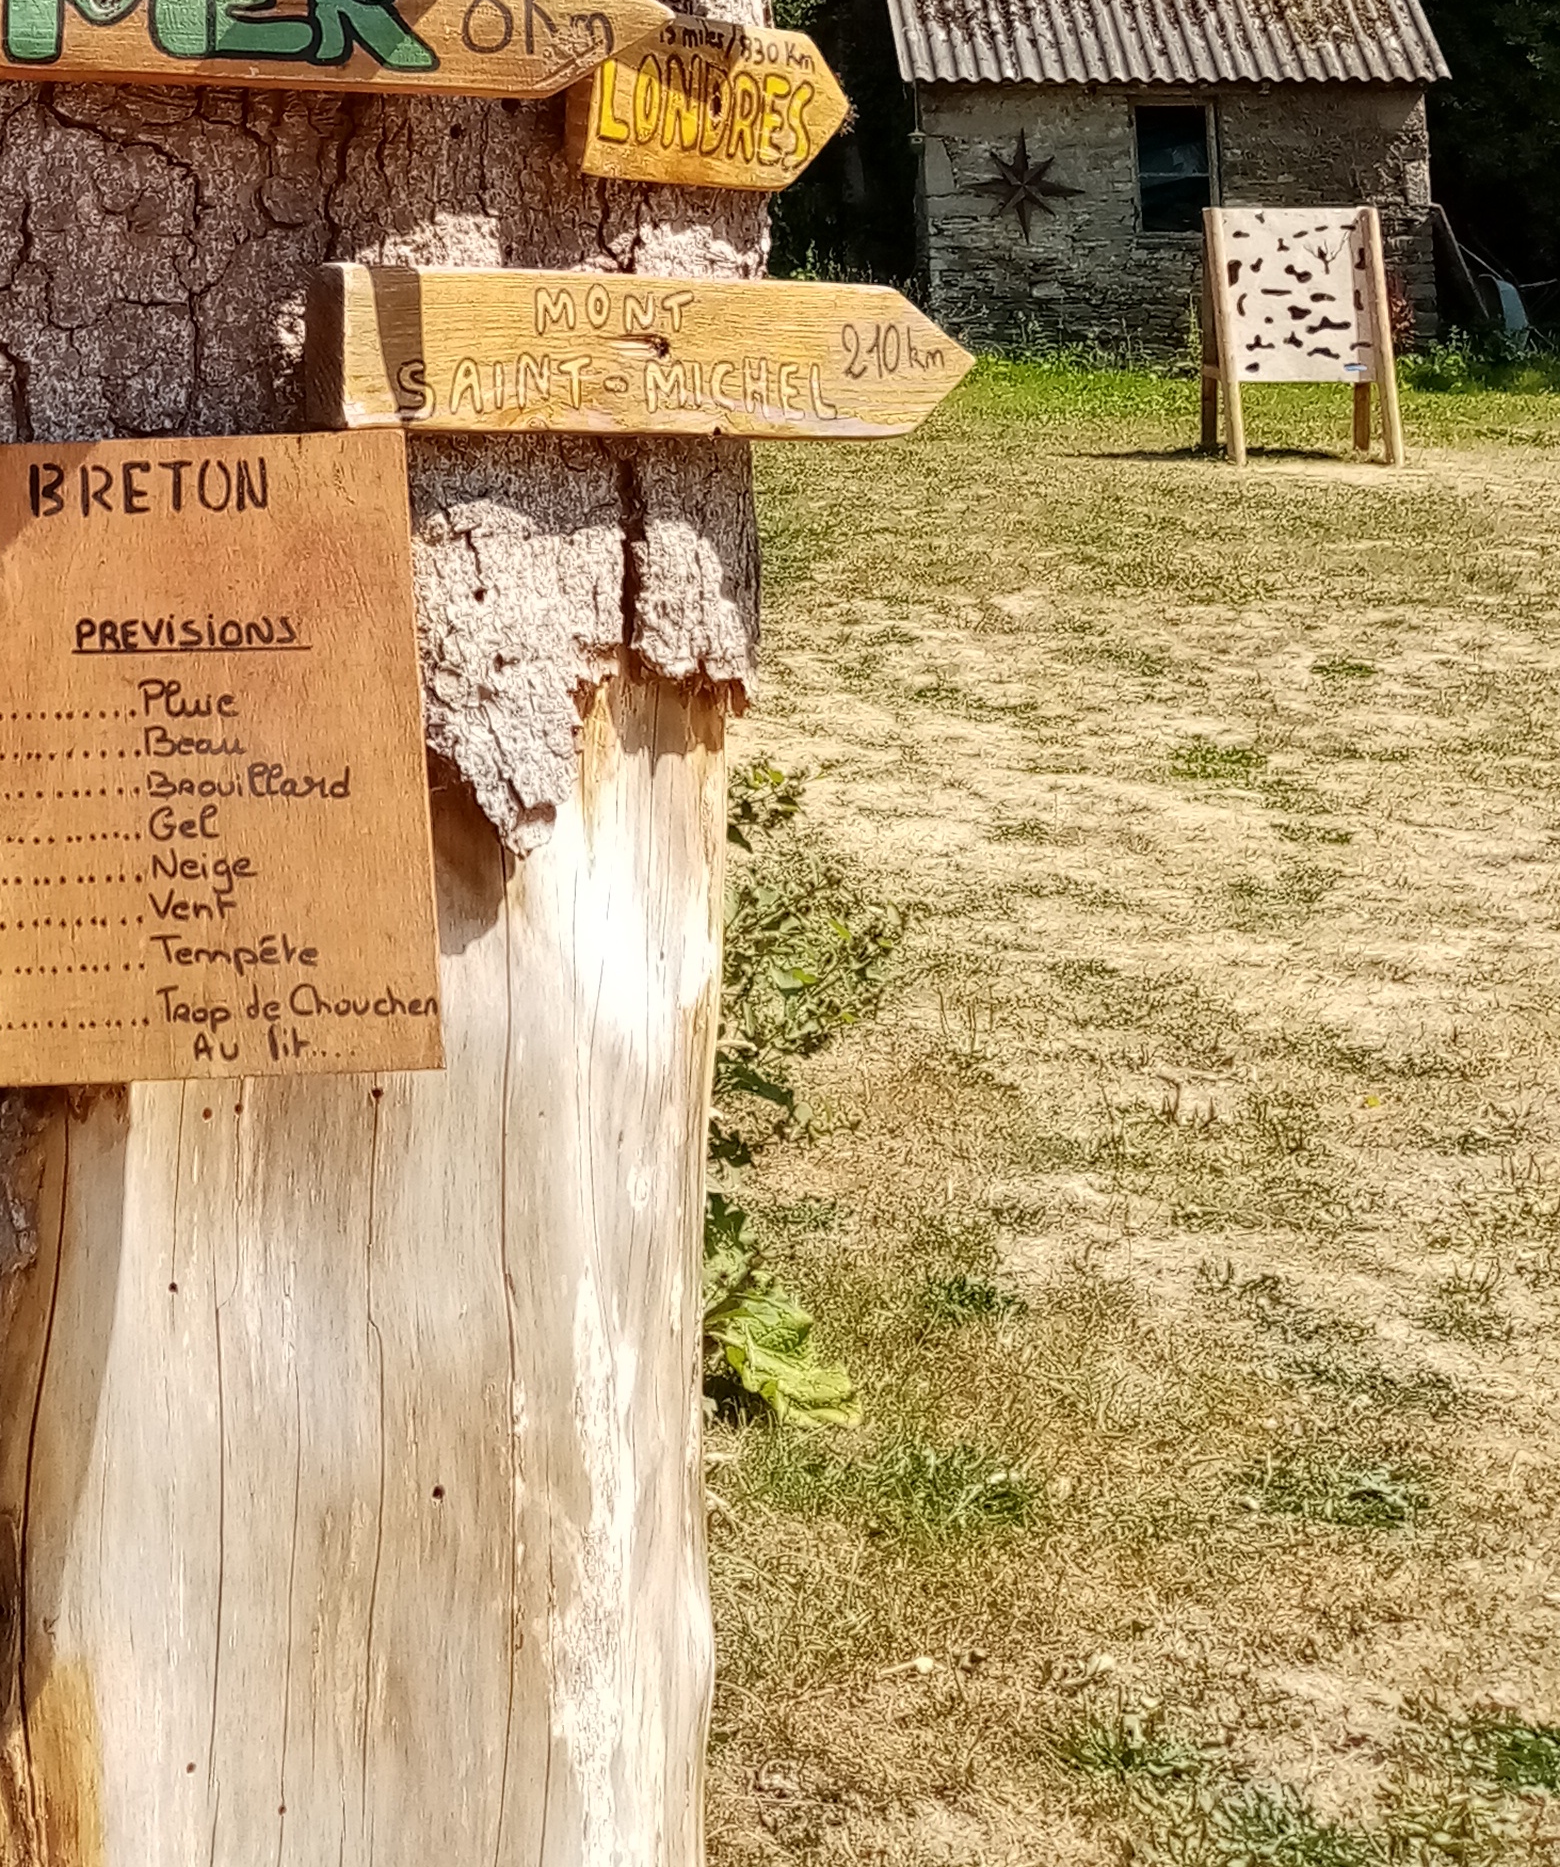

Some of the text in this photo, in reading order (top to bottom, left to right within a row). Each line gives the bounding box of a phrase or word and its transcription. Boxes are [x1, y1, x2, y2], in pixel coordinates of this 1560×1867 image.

[596, 52, 816, 171] LONDRES
[534, 282, 696, 334] MONT
[394, 351, 839, 424] SAINT-MICHEL
[27, 456, 270, 518] BRETON
[138, 678, 240, 718] Pluie
[144, 725, 247, 758] Beau
[149, 803, 220, 842] Gel
[151, 848, 258, 894] Neige
[149, 890, 237, 922] Vent
[150, 932, 320, 976] Tempête
[246, 983, 282, 1020] de
[289, 982, 440, 1018] Chouchen
[193, 1034, 239, 1063] Au
